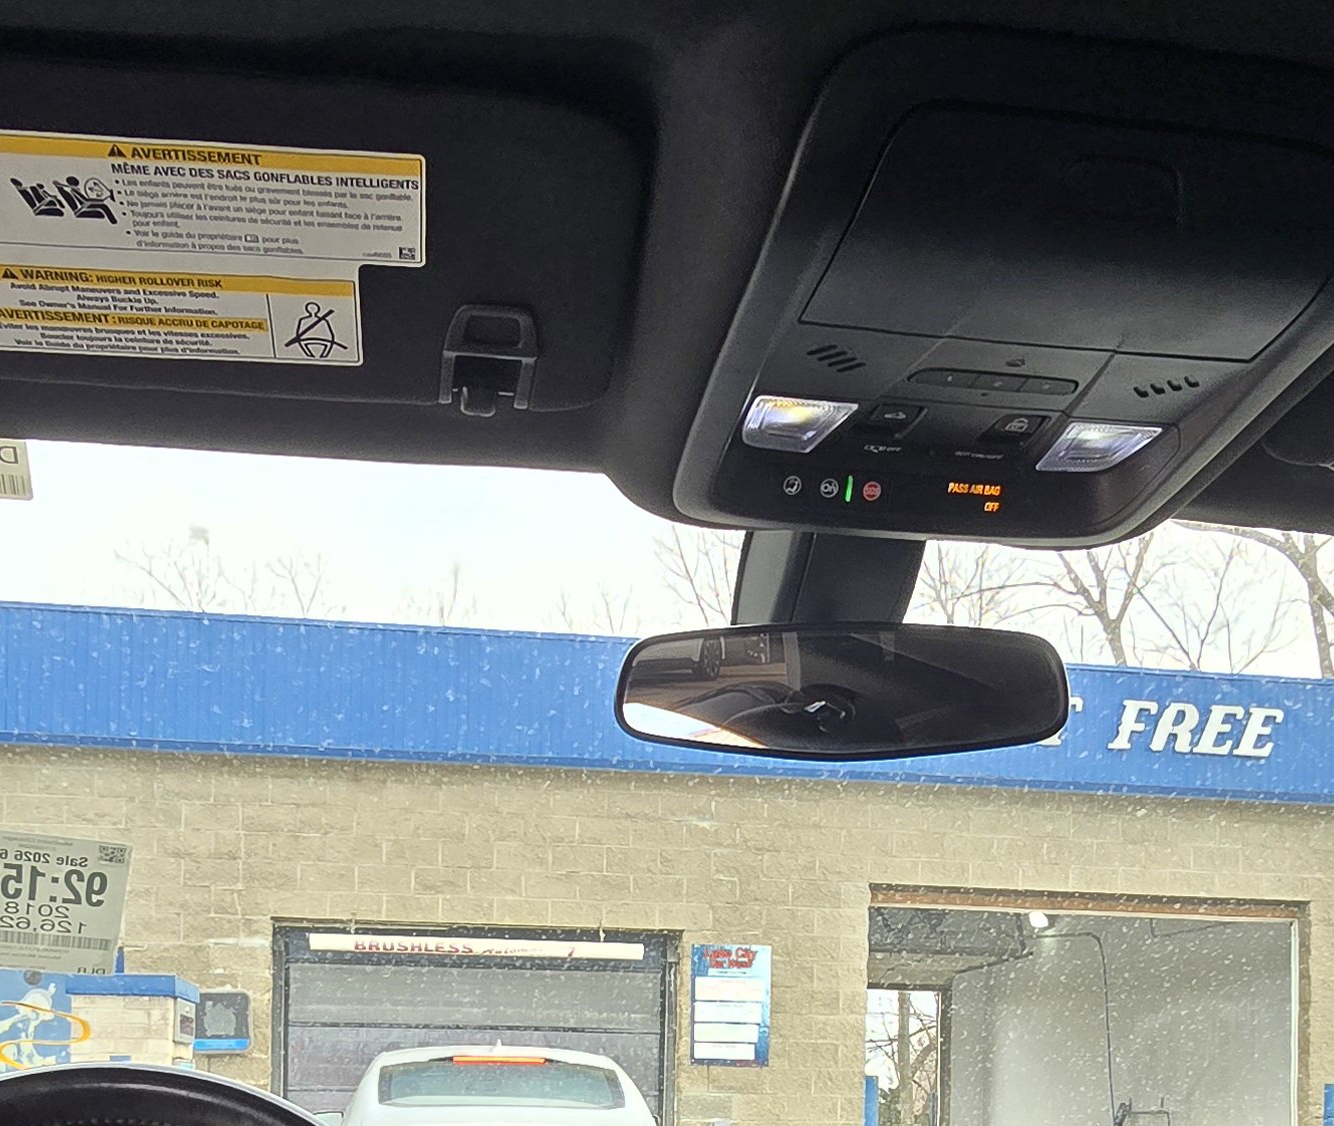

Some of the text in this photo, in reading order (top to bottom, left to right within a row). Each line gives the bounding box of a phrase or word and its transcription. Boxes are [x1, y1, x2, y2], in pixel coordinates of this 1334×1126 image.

[131, 147, 263, 165] AVERTISSEMENT
[111, 161, 419, 190] MÊME AVEC DES SACS GONFLABLES INTELLIGENTS
[20, 269, 223, 288] WARNING: HIGHER ROLLOVER RISK
[118, 316, 156, 326] RISQUE
[158, 318, 193, 328] ACCRU
[196, 320, 209, 329] DE
[211, 320, 265, 330] CAPOTAGE
[948, 482, 1001, 496] PASS AIR BAG
[984, 502, 1000, 512] OFF
[1108, 699, 1283, 758] FREE
[354, 940, 475, 954] BRUSHLESS
